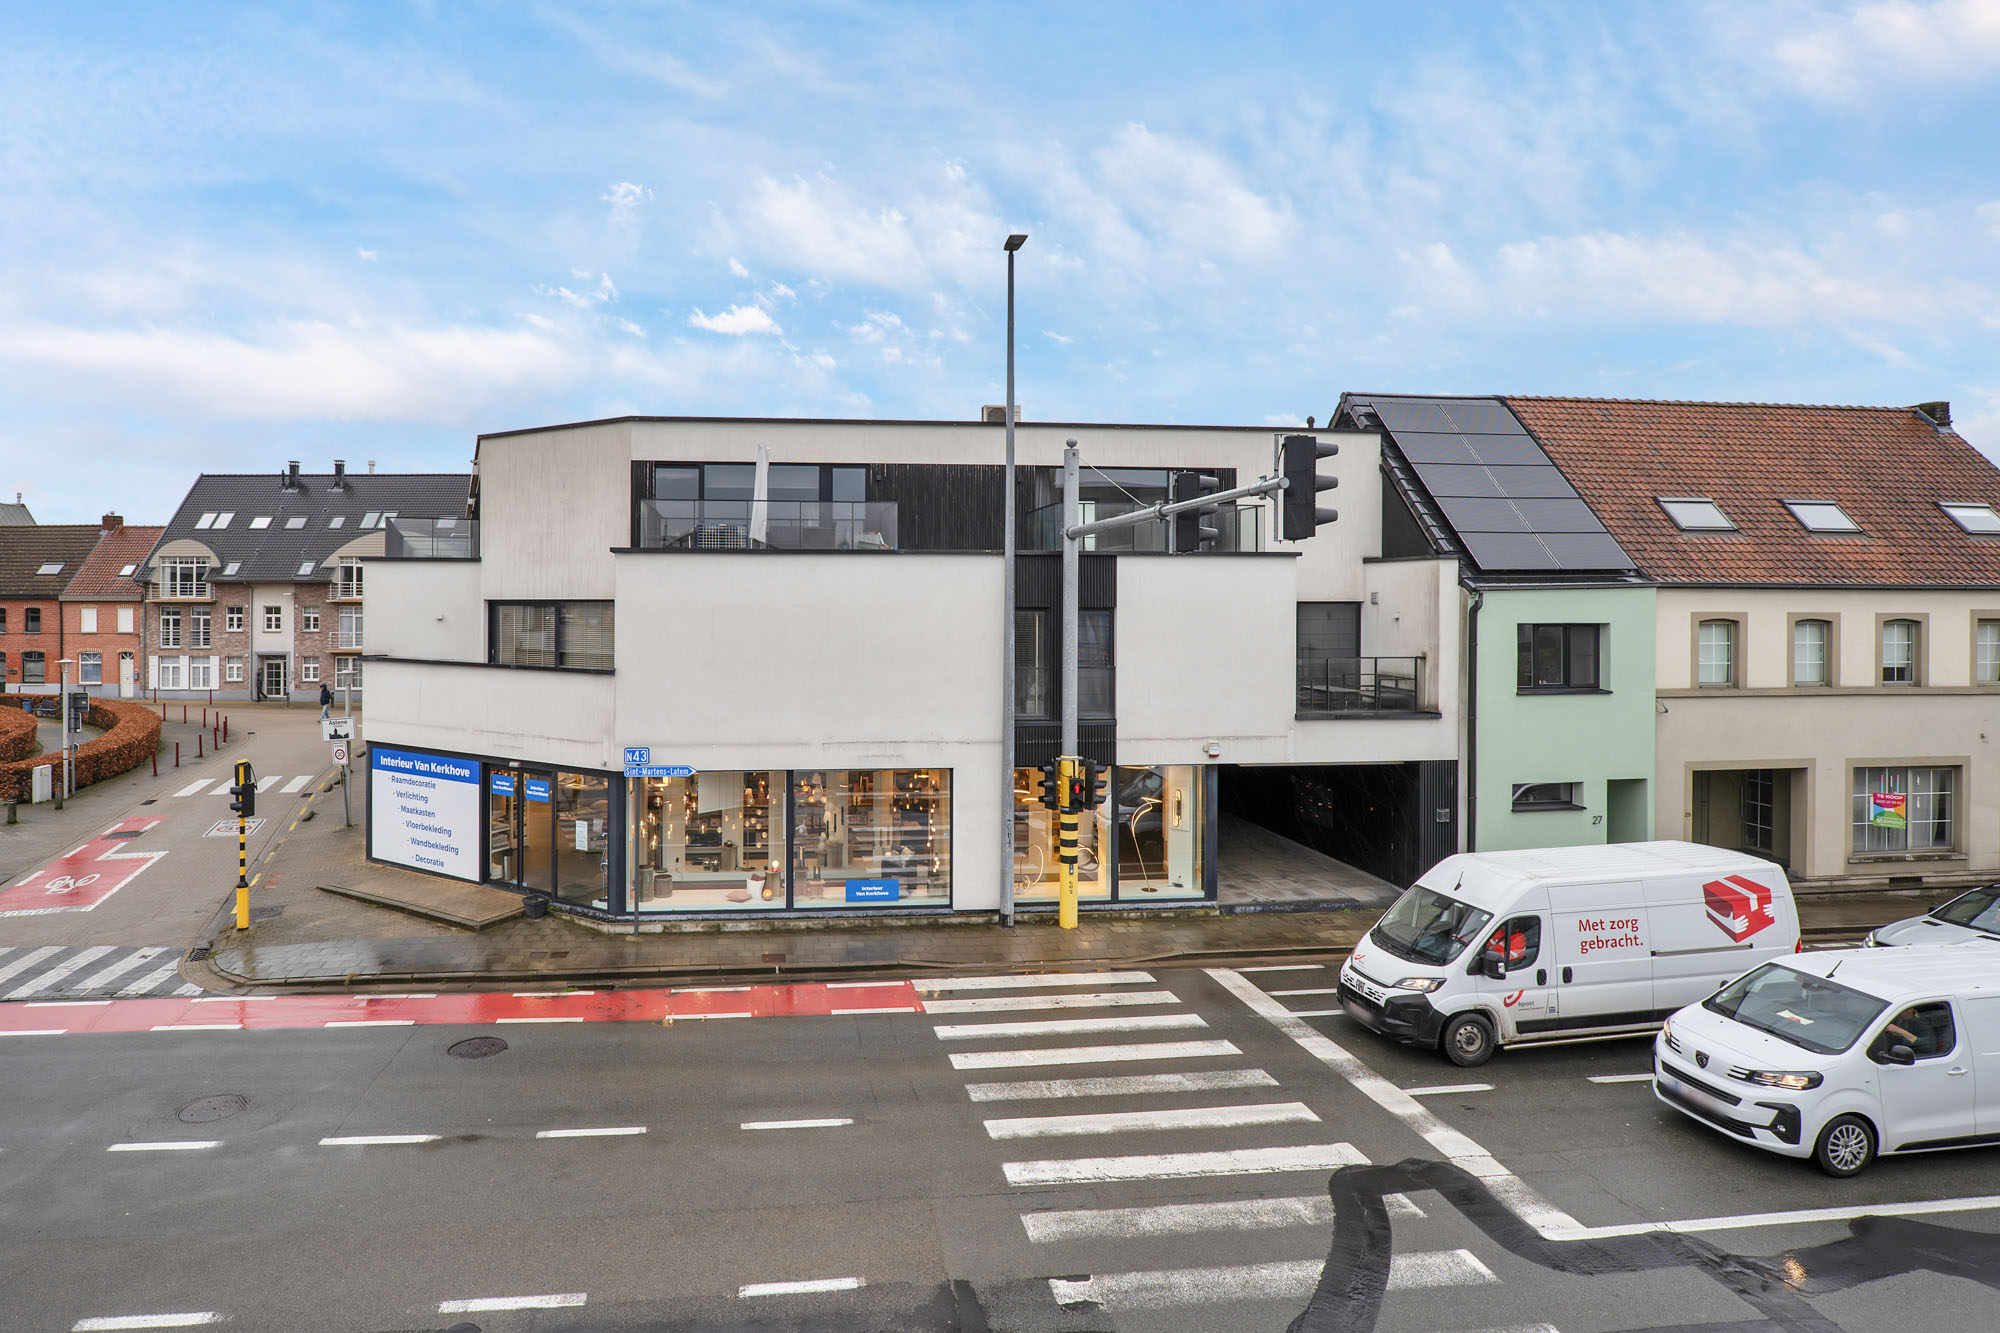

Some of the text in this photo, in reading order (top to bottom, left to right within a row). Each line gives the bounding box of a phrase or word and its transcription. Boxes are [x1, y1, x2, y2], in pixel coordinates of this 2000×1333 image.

[626, 750, 647, 762] N43
[380, 755, 470, 777] Interieur Van Kerkhove
[625, 767, 689, 776] Sint-Martens-Latem
[391, 775, 436, 789] Raamdecoratie
[395, 790, 429, 804] Verlichting
[400, 805, 436, 818] Maatkasten
[1592, 815, 1603, 825] 27
[405, 820, 452, 837] Vloerbekleding
[410, 837, 459, 856] Wandbekleding
[415, 854, 445, 868] Decoratie
[1578, 918, 1639, 932] Met zorg
[1580, 933, 1643, 954] gebracht.
